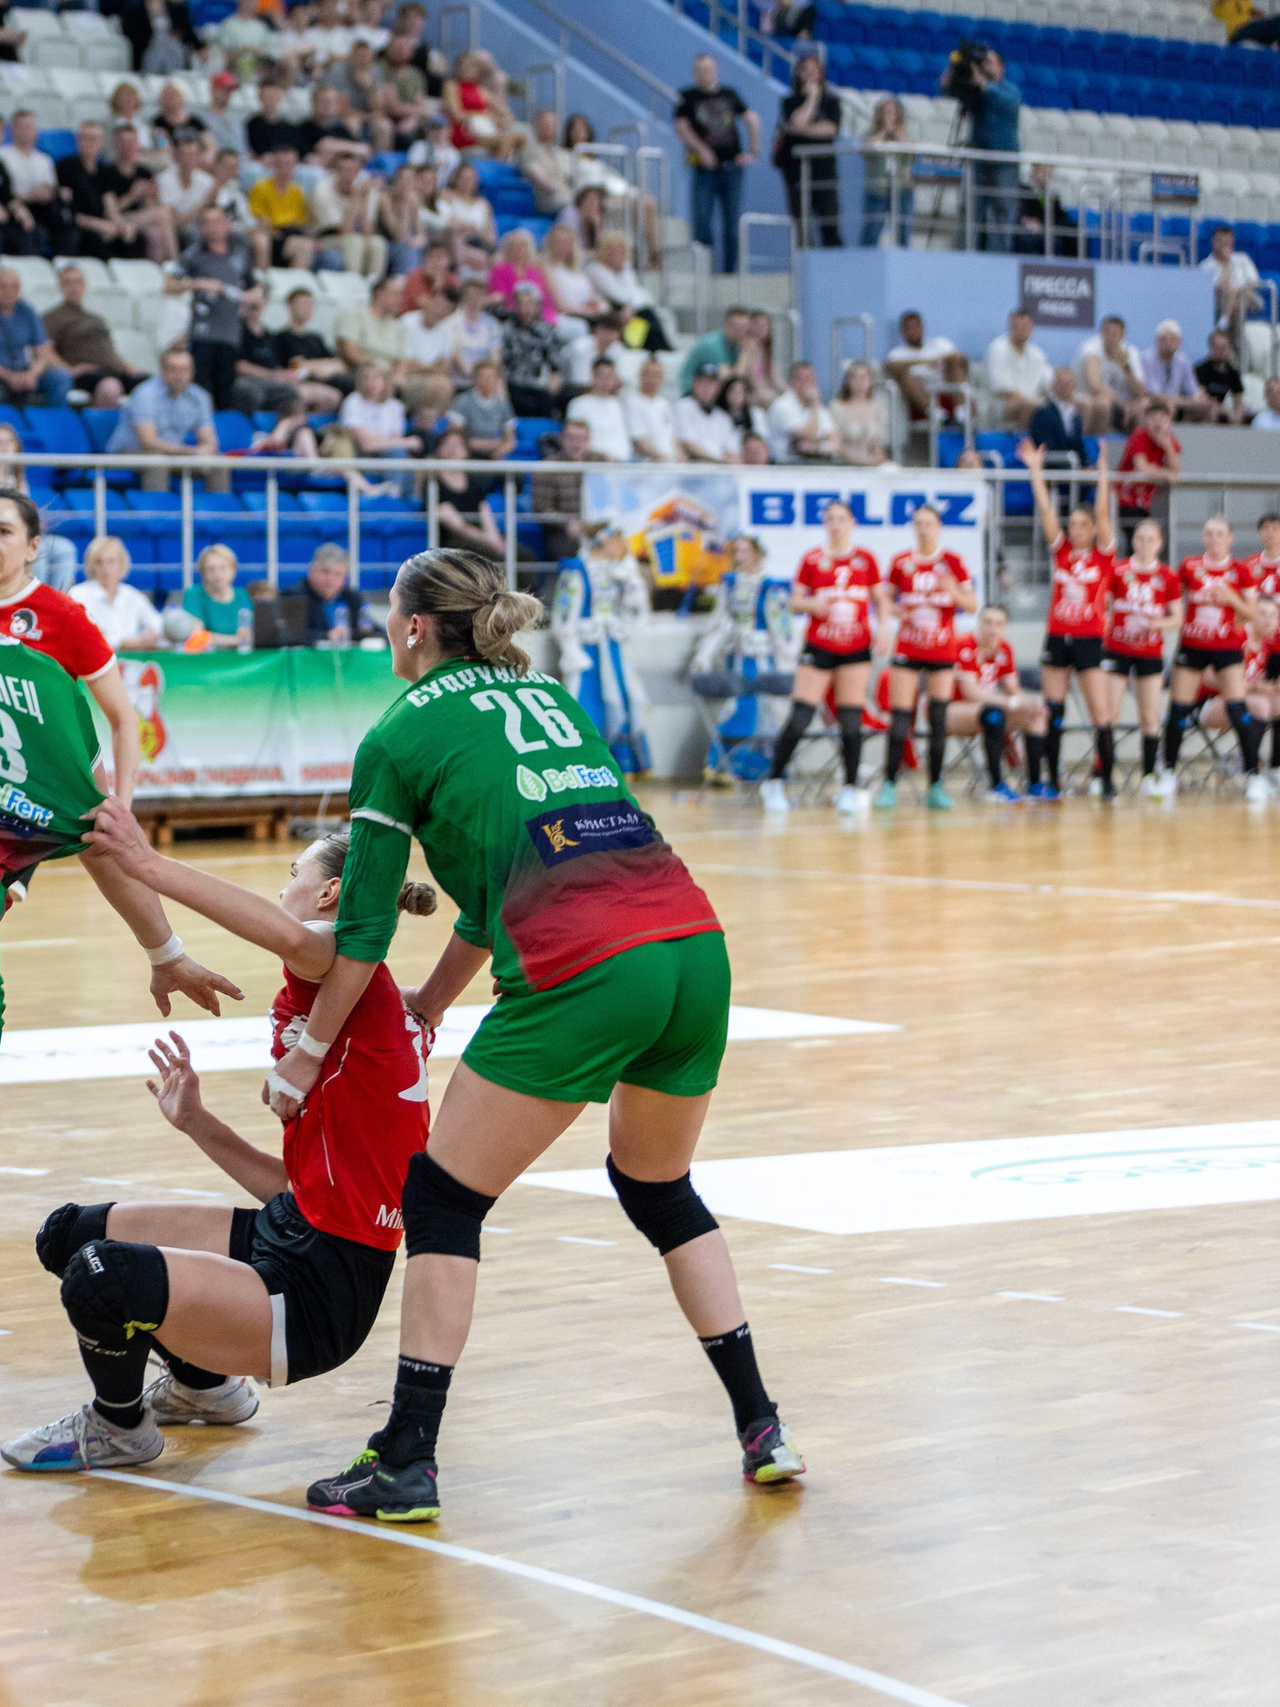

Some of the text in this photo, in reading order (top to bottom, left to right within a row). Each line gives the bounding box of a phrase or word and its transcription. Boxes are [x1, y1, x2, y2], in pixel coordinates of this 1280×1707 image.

[1024, 274, 1091, 299] ПРЕССА
[470, 688, 582, 754] 26
[542, 765, 618, 793] BelFert
